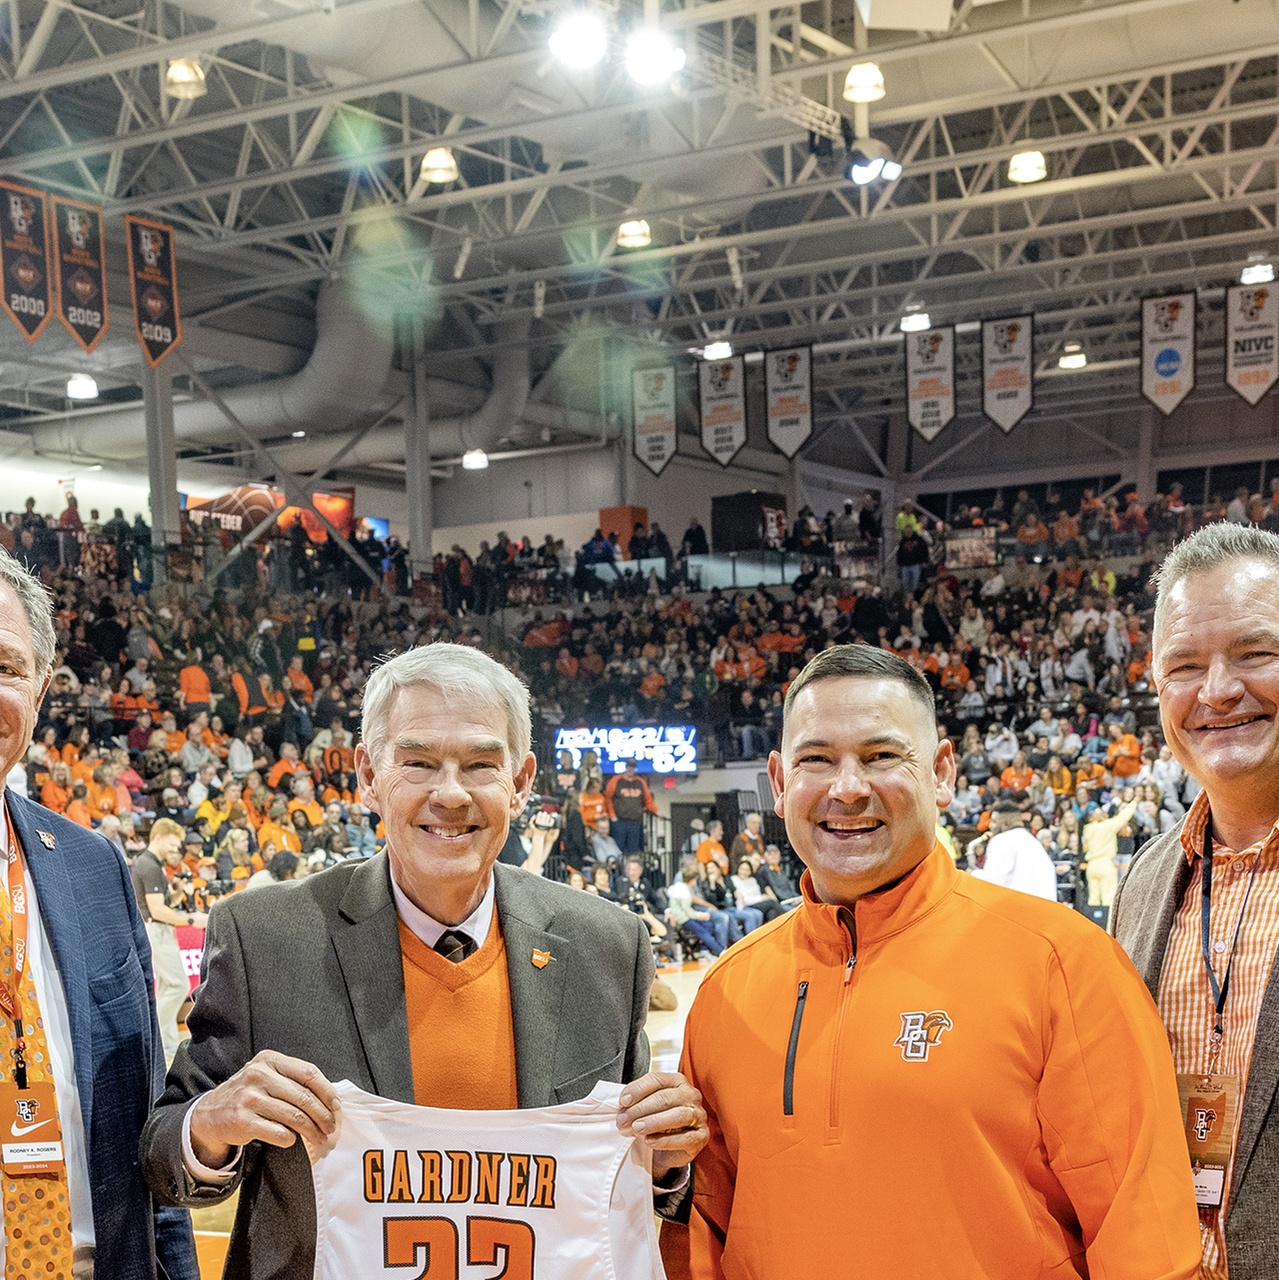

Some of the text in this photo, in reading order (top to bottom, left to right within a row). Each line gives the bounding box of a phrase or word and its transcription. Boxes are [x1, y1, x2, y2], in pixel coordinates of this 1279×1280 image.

[10, 293, 45, 317] 2000
[67, 306, 102, 329] 2002
[141, 321, 172, 343] 2009
[1233, 335, 1275, 354] NIVC
[11, 883, 26, 915] BGSU
[16, 938, 26, 973] BGSU
[362, 1149, 558, 1209] GARDNER
